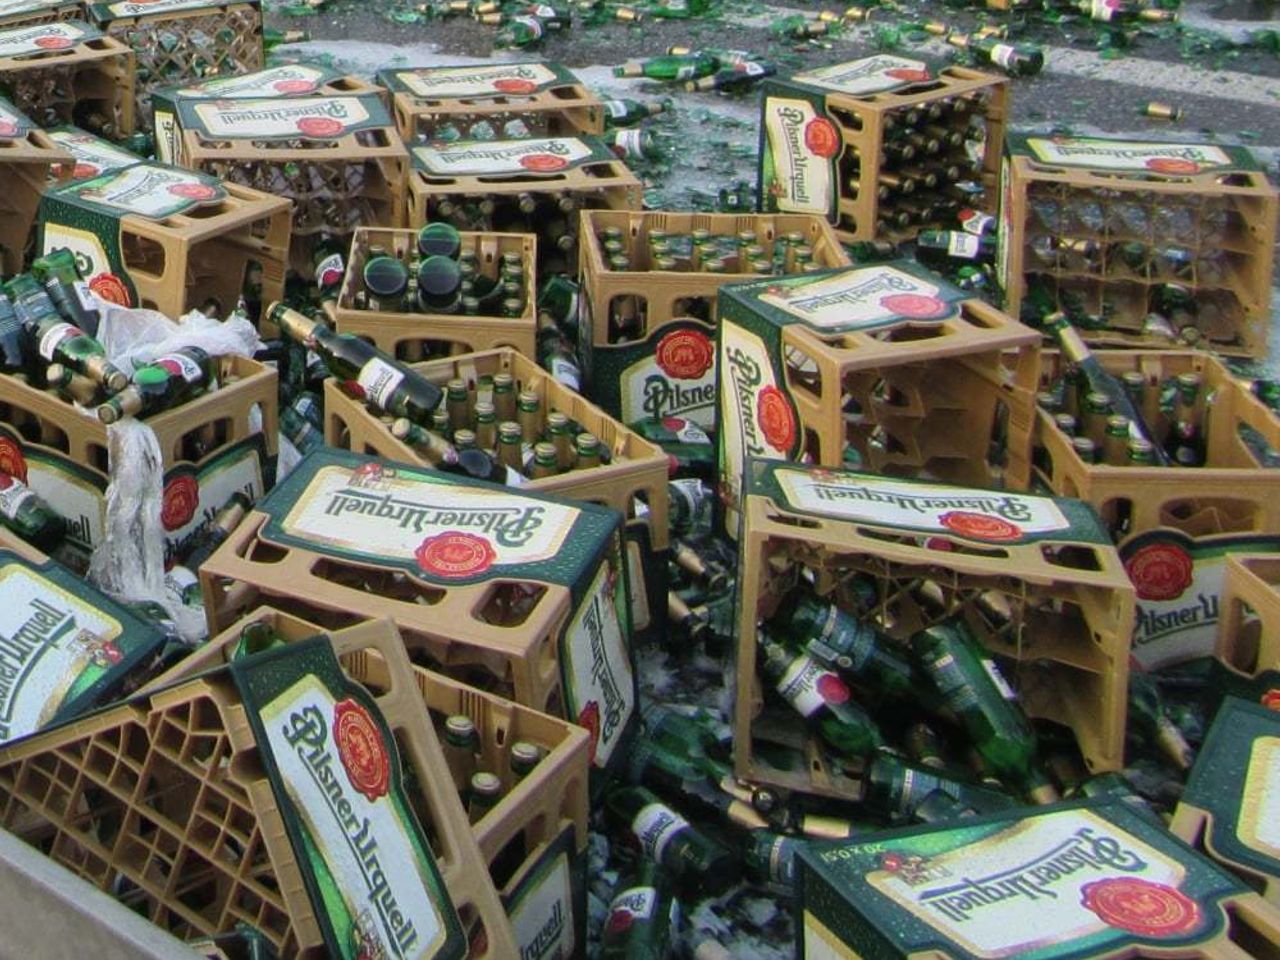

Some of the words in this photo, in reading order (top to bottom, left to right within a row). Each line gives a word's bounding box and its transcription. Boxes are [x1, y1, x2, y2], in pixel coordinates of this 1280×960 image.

[777, 107, 805, 156] Pilsner
[789, 155, 810, 204] Urquell
[643, 374, 715, 422] Pilsne
[726, 346, 762, 444] Pilsner
[324, 493, 424, 533] Urquell
[818, 486, 926, 514] Urquell
[926, 496, 1033, 522] Pilsner
[426, 506, 546, 547] Pilsner
[283, 703, 361, 832] Pilsner
[353, 817, 418, 953] Urquell
[1032, 828, 1147, 891] Pilsner
[930, 876, 1058, 922] Urquell
[522, 900, 562, 960] rquell
